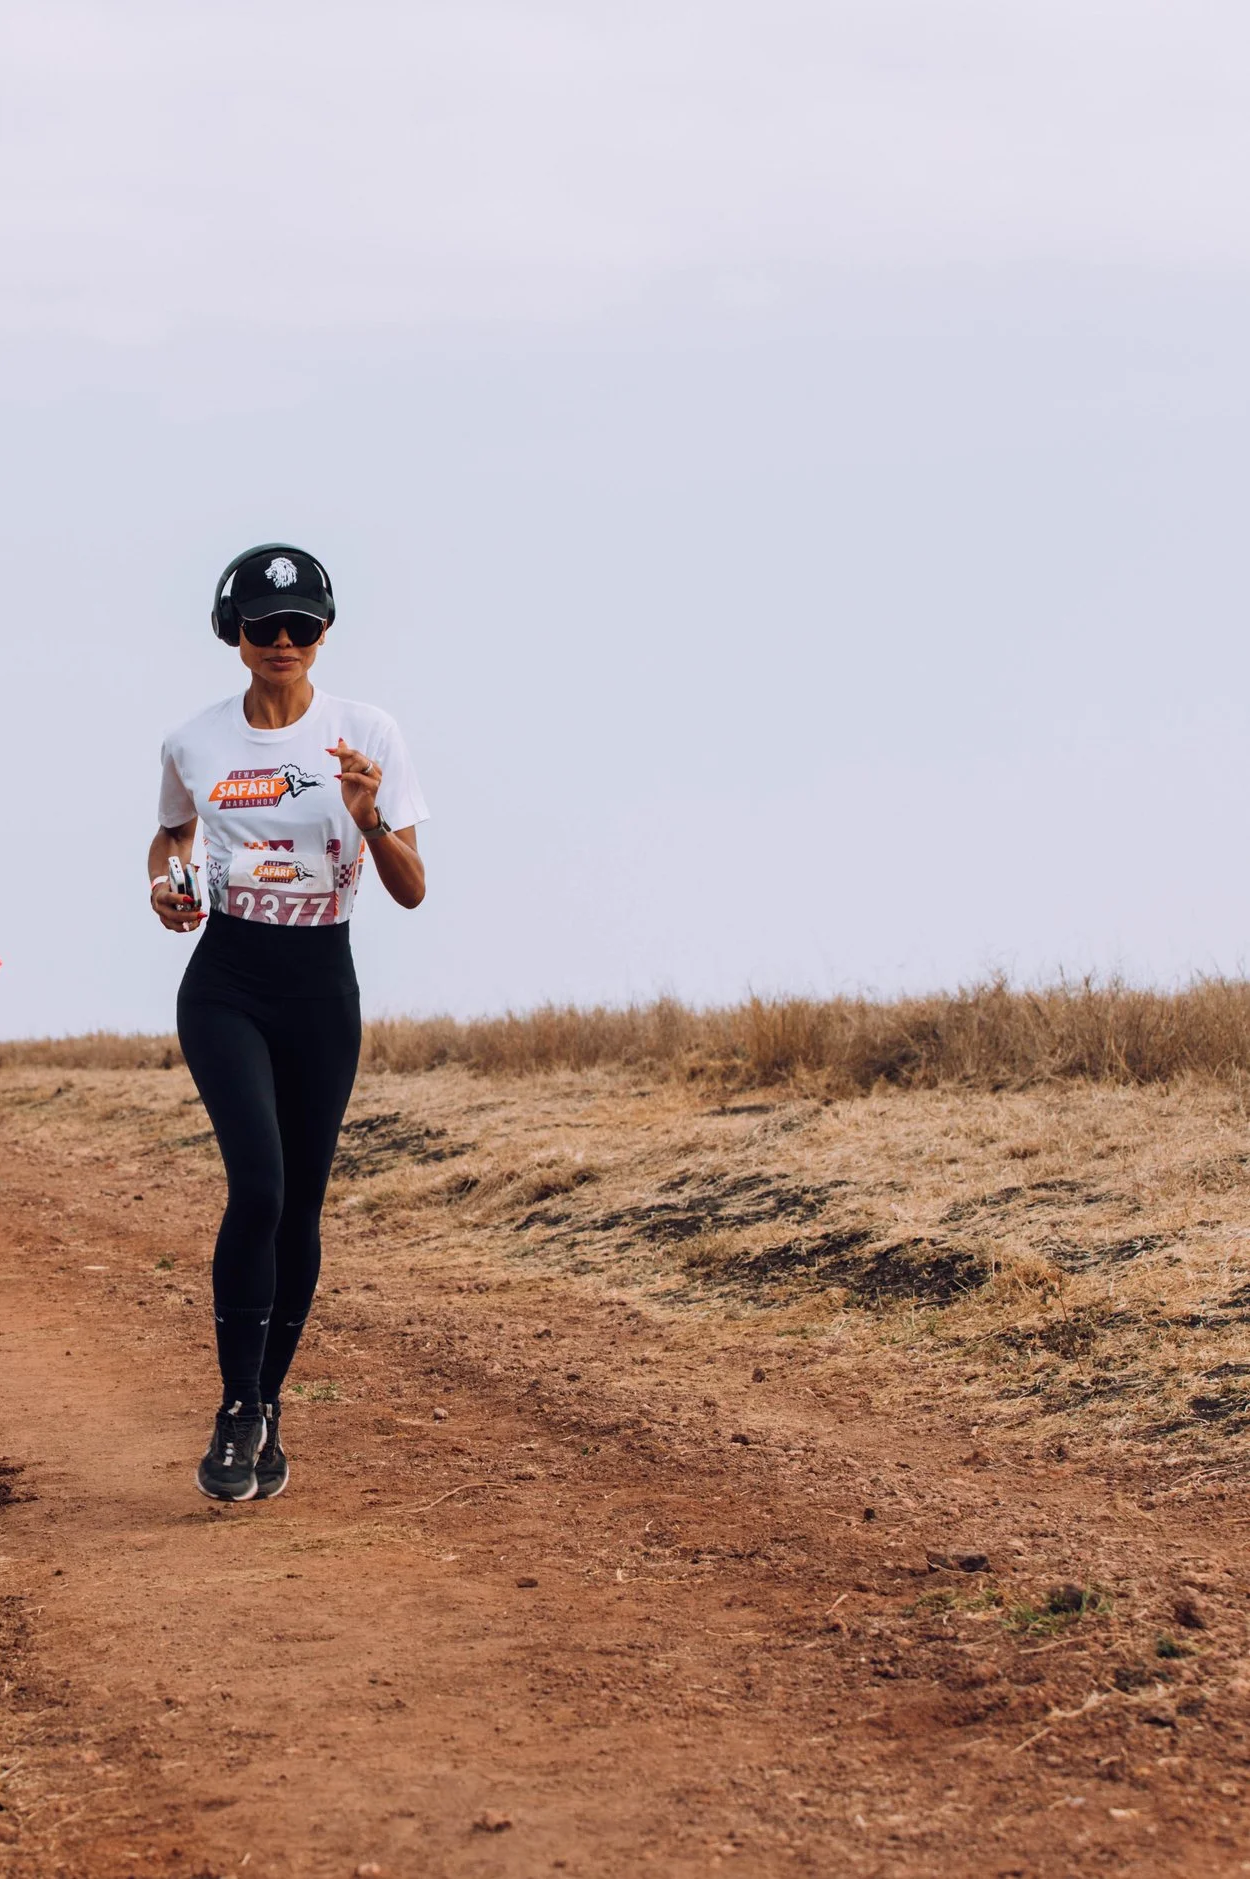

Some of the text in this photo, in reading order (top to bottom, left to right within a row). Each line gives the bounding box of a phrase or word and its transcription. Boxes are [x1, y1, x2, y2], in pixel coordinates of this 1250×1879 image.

[232, 771, 256, 779] LEWA
[217, 781, 276, 798] SAFARI
[225, 798, 274, 807] MARATHON
[258, 866, 290, 878] SAFARI
[236, 892, 331, 926] 2377
